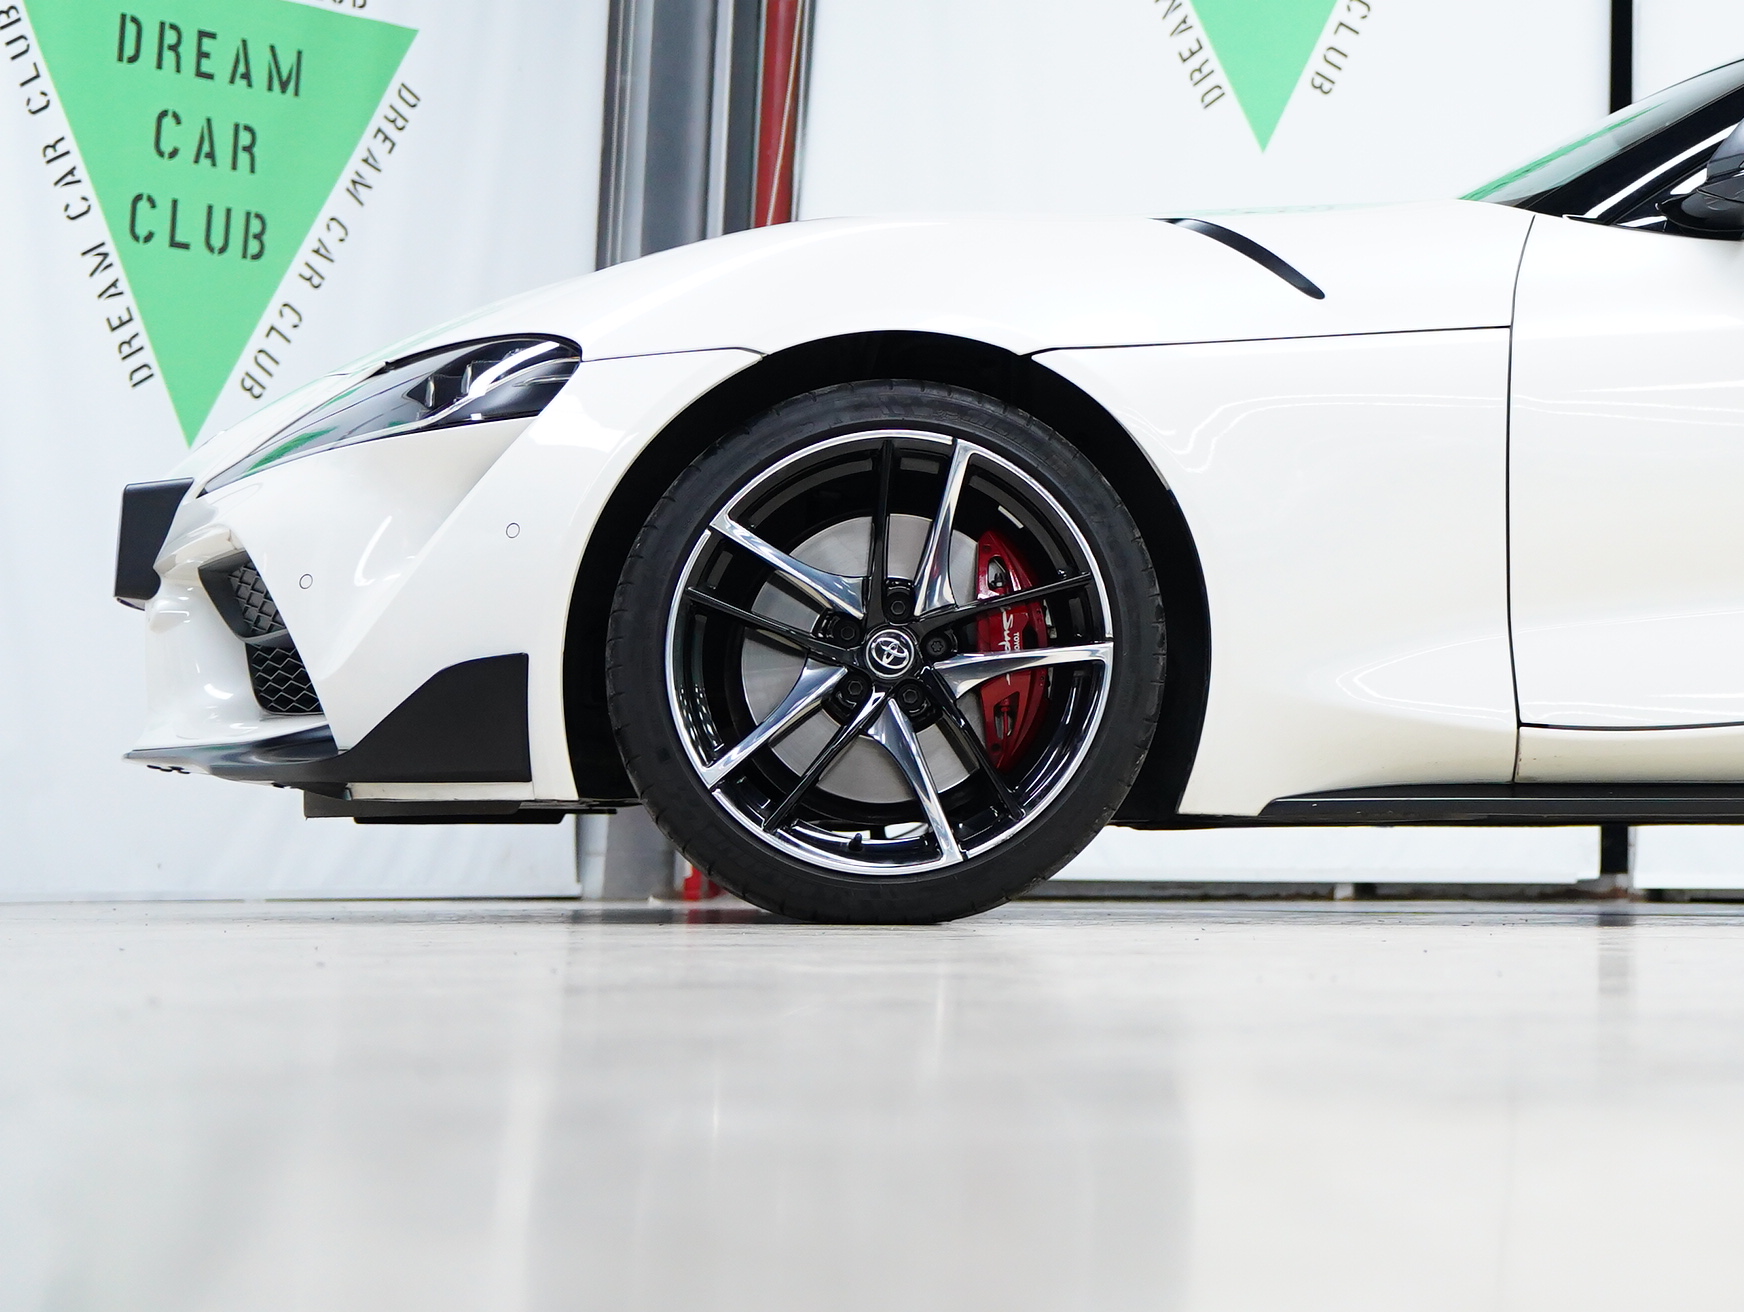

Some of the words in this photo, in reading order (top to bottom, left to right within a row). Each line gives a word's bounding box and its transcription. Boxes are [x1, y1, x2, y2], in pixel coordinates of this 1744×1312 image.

[0, 5, 51, 115] CLUB
[116, 12, 303, 97] DREAM
[42, 136, 91, 221] CAR
[153, 109, 257, 175] CAR
[345, 82, 421, 207] DREAM
[129, 192, 267, 261] CLUB
[298, 216, 349, 290] CAR
[80, 241, 155, 388] DREAM
[240, 302, 303, 400] CLUB
